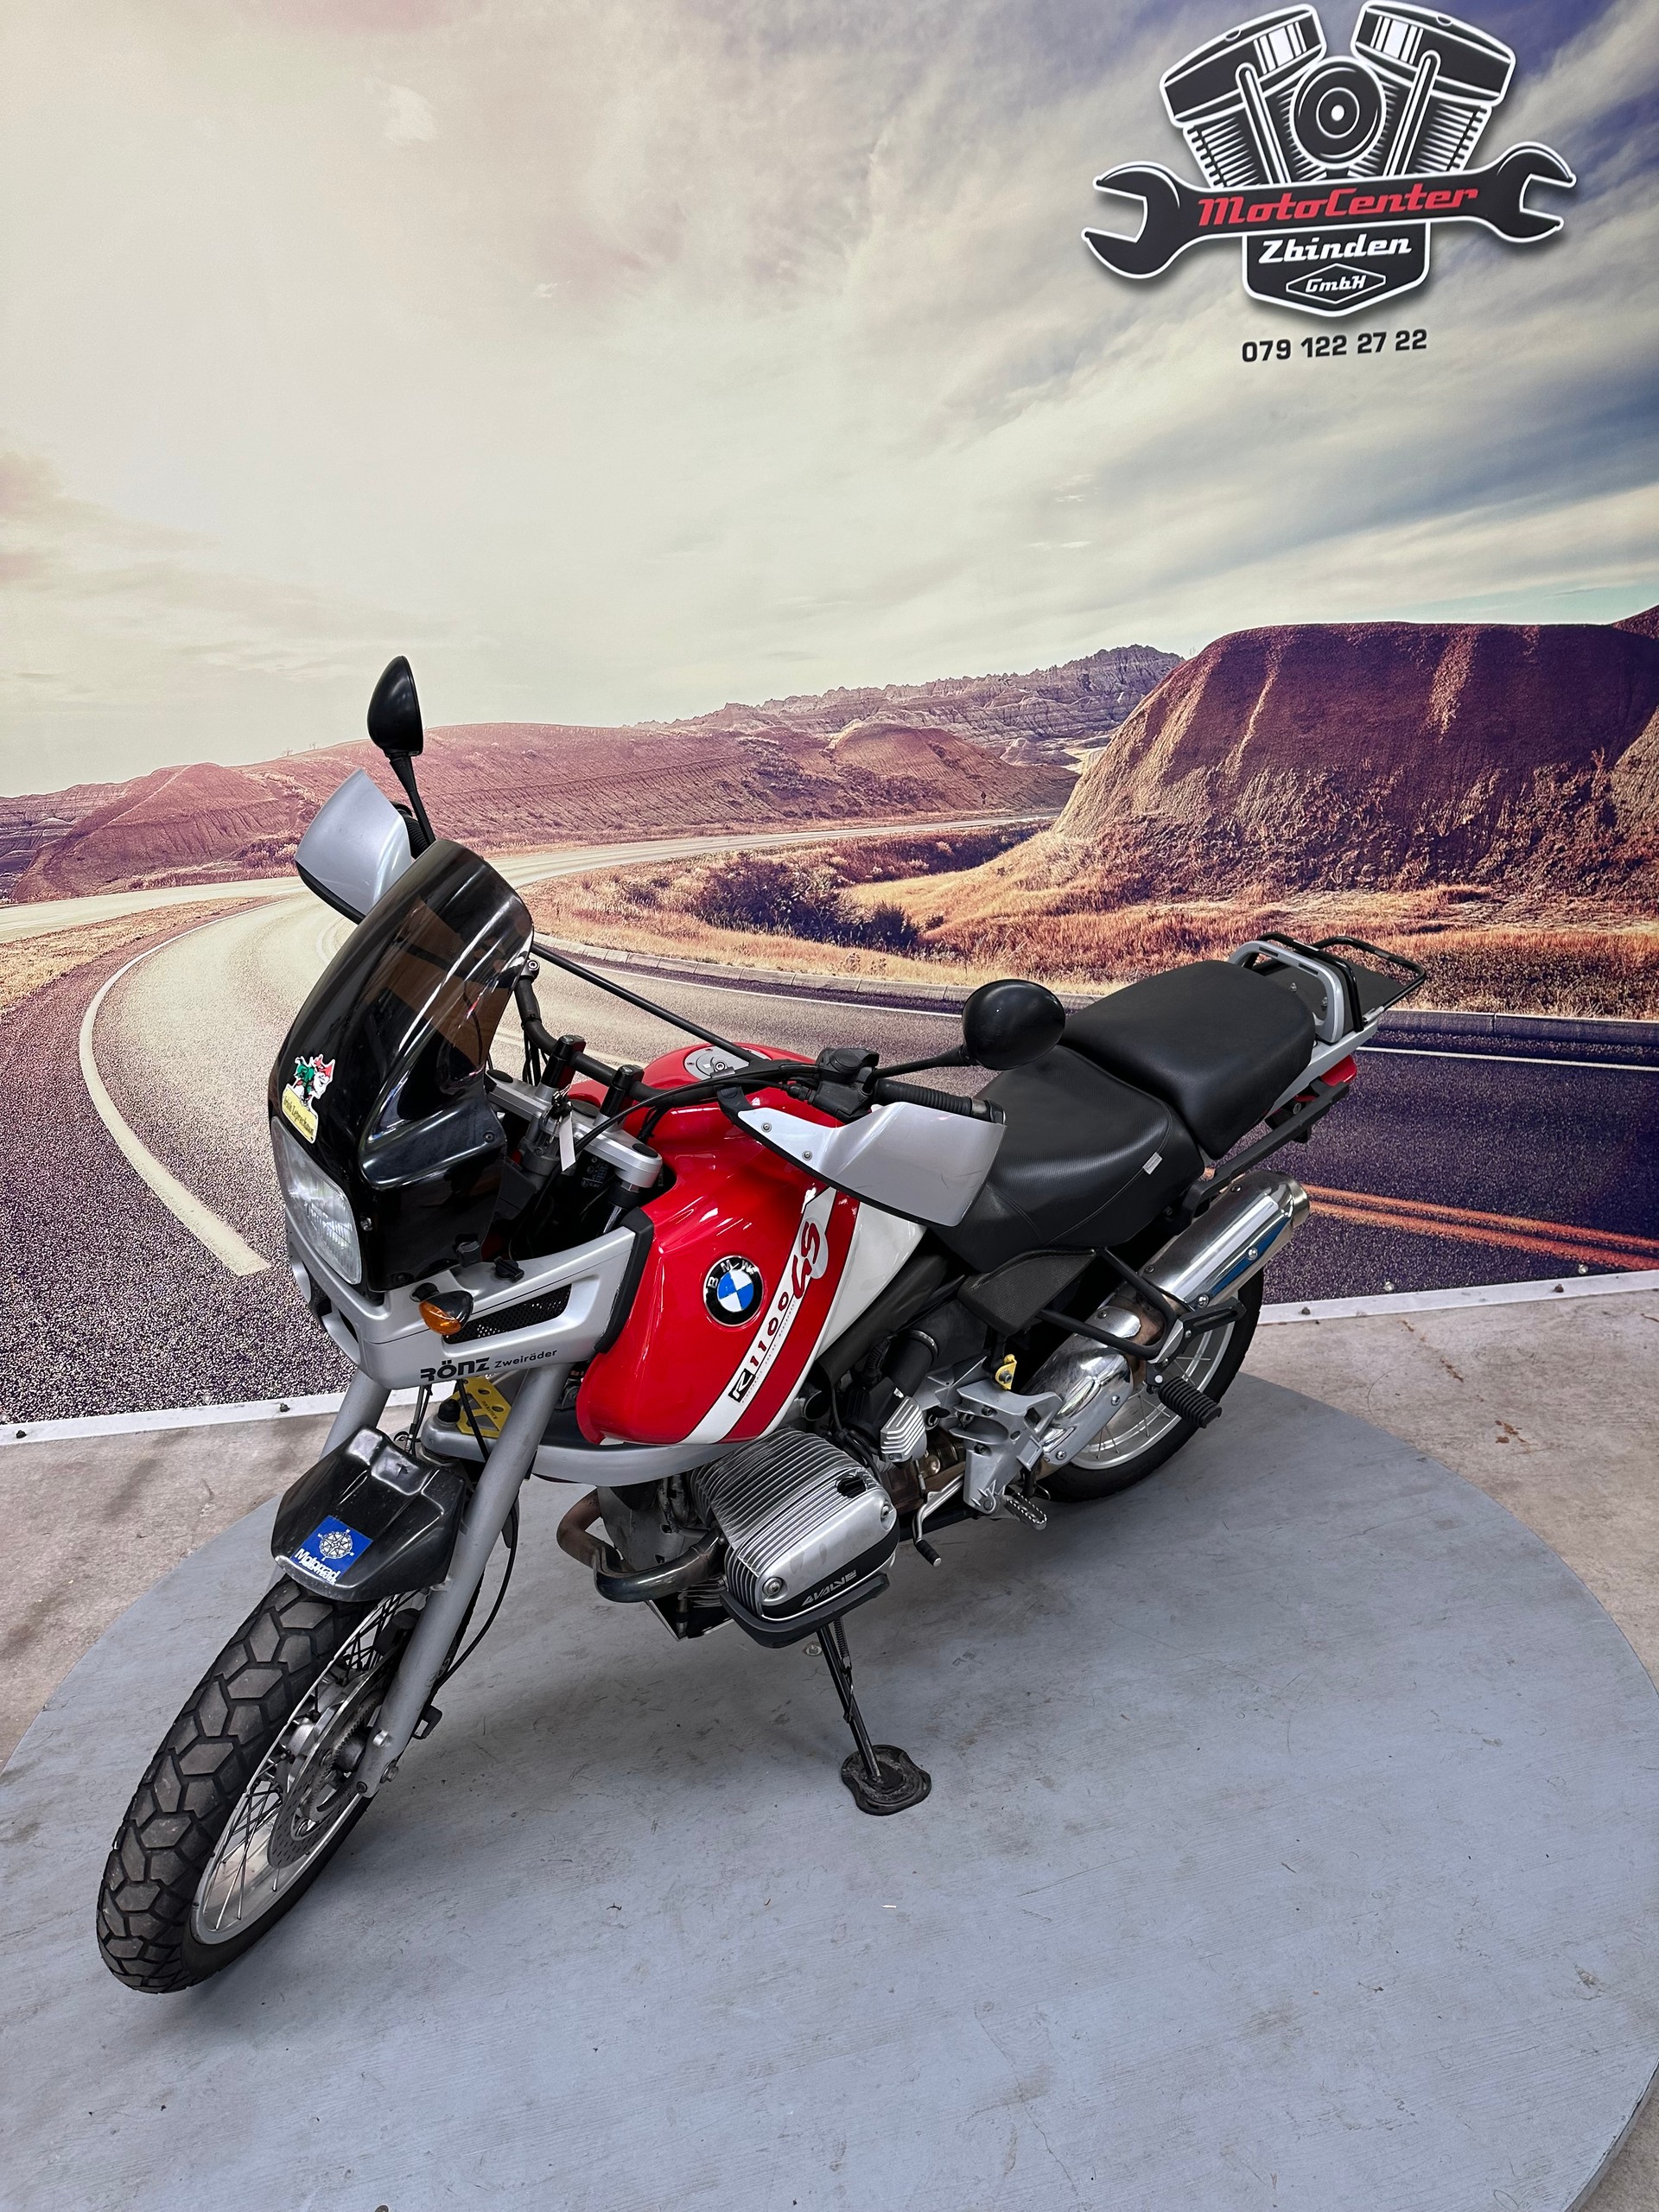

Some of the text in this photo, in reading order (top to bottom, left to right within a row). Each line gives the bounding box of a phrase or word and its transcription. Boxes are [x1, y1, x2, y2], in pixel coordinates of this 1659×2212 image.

[1198, 183, 1478, 226] MotoCenter
[1258, 233, 1412, 264] Zbinden
[1304, 274, 1367, 293] GmbH
[1242, 328, 1427, 363] 079 122 27 22
[707, 1259, 757, 1289] BMW
[791, 1220, 821, 1300] GS
[494, 1350, 557, 1369] Zweiräder
[294, 1548, 341, 1580] Motorrad
